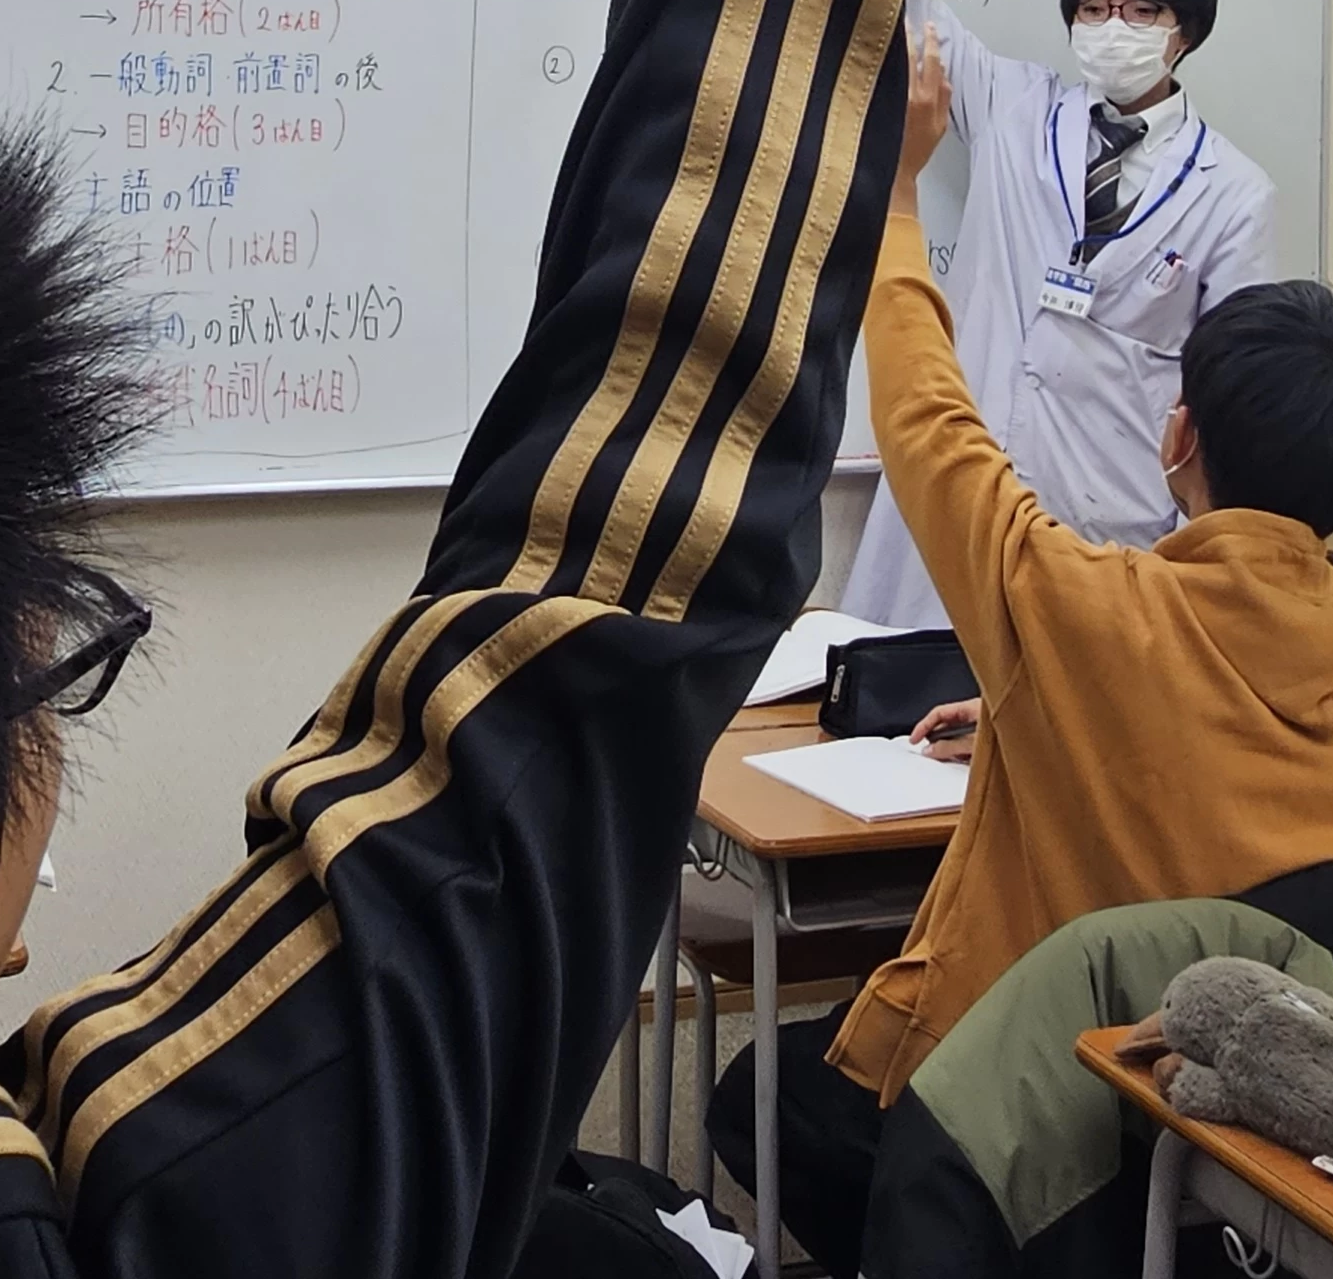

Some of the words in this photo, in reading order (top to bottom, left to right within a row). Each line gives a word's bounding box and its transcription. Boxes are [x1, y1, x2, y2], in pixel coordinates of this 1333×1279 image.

[84, 166, 240, 215] 主語の位置
